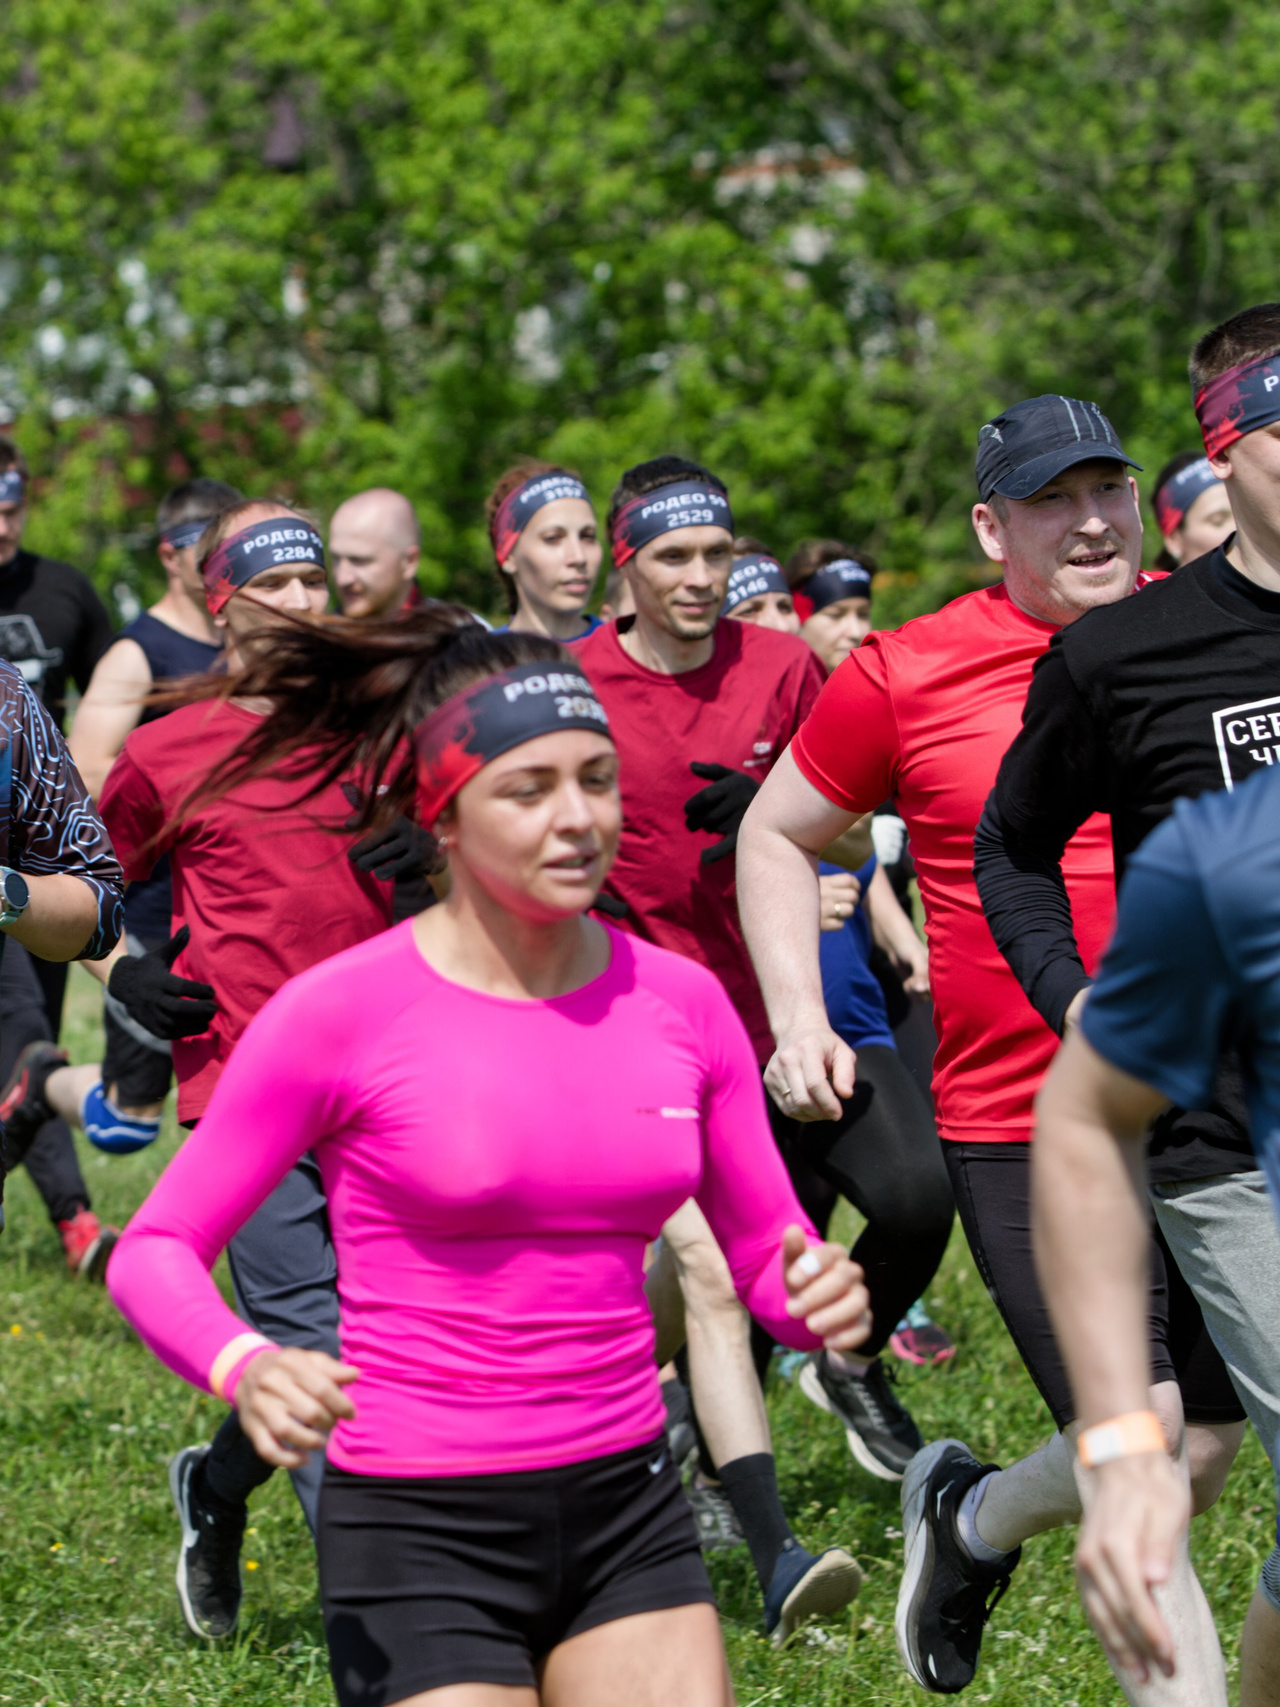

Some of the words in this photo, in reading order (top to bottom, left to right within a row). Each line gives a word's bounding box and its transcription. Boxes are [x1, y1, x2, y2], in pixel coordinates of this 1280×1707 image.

[641, 492, 707, 520] РОДЕО
[666, 508, 714, 529] 2529
[242, 528, 309, 555] РОДЕО
[272, 545, 316, 562] 2284
[726, 576, 769, 606] 3146
